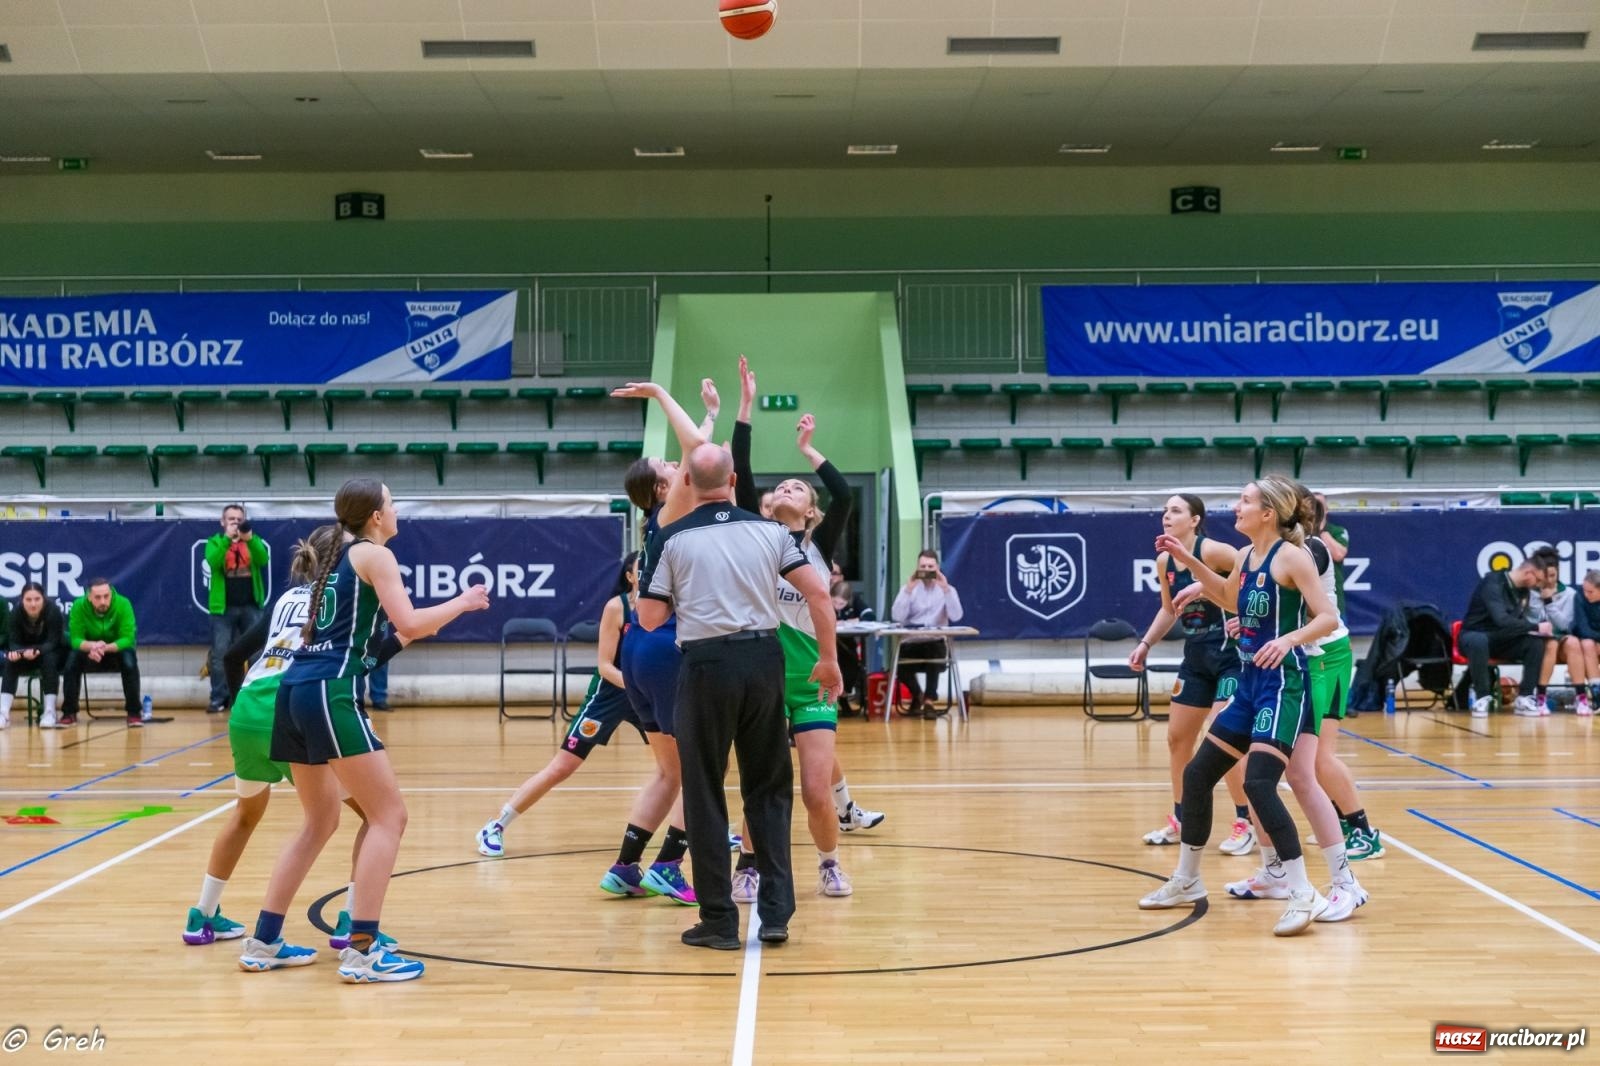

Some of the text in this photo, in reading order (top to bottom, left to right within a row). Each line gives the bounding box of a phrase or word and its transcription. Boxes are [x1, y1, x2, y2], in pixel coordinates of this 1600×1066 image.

[340, 201, 351, 217] B
[362, 201, 379, 216] B
[1176, 195, 1193, 210] C
[1204, 195, 1217, 210] C
[0, 309, 157, 339] KADEMIA
[269, 311, 370, 327] Dołącz do nas!
[1084, 312, 1439, 343] www.uniaraciborz.eu
[1503, 317, 1545, 346] UNIA
[0, 333, 244, 369] NII RACIBÓRZ
[410, 327, 454, 356] UNIA
[1246, 589, 1270, 617] 26
[1216, 677, 1238, 699] 10
[1252, 707, 1273, 733] 6
